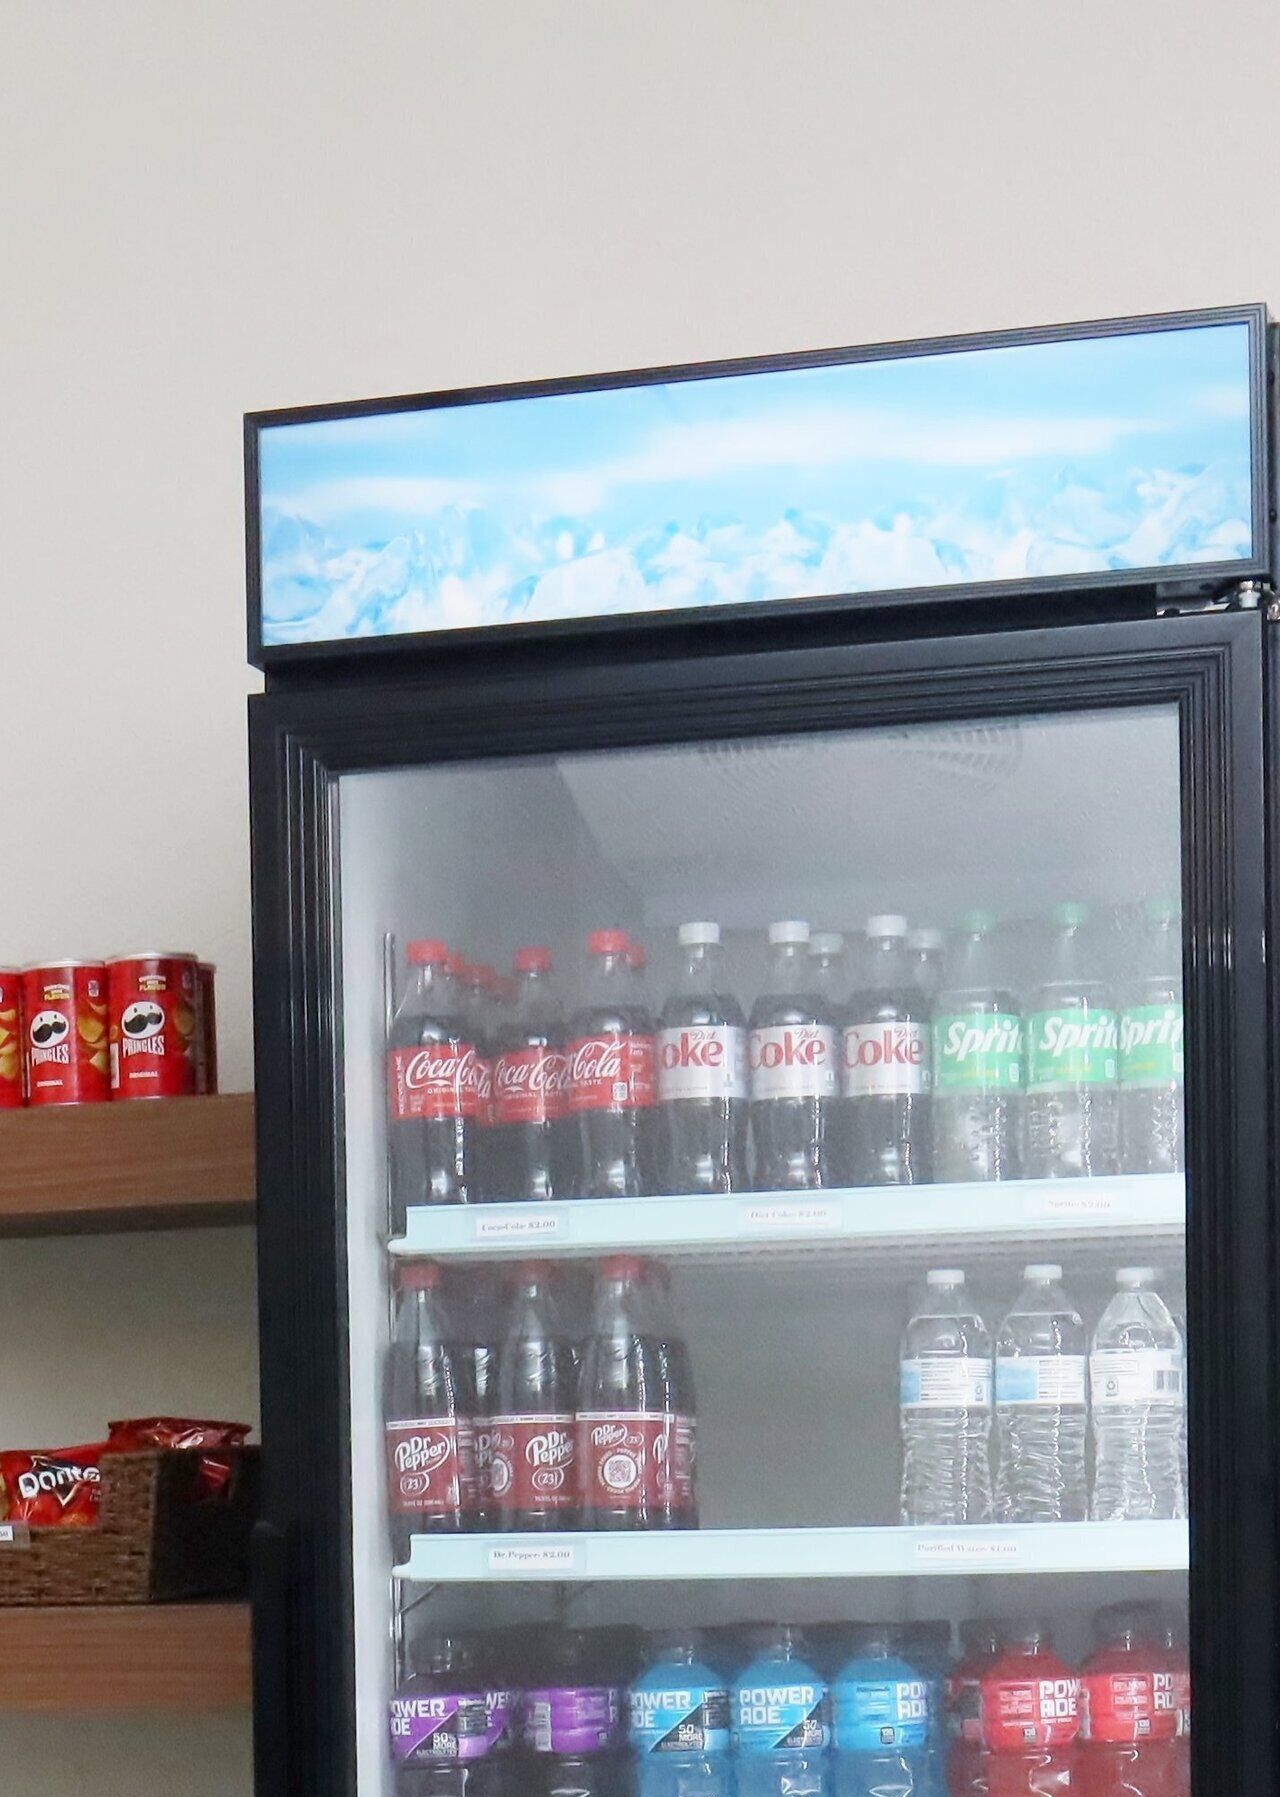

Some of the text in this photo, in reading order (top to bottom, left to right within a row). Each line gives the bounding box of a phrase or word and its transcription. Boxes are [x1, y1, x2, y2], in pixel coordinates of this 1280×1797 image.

[1120, 1009, 1183, 1055] Sprit
[122, 1034, 165, 1059] PRINGLES
[662, 1032, 724, 1070] oke
[844, 1029, 924, 1068] Coke
[528, 1219, 557, 1230] $2.00
[409, 1435, 431, 1455] Dr
[546, 1430, 567, 1450] Dr
[397, 1442, 447, 1472] Pepper
[527, 1436, 574, 1466] Peppe
[635, 1690, 690, 1711] OWER
[740, 1685, 815, 1706] POWER
[392, 1698, 445, 1718] OWER
[740, 1706, 781, 1725] ADE
[1040, 1697, 1077, 1718] ADE
[391, 1717, 410, 1736] DE
